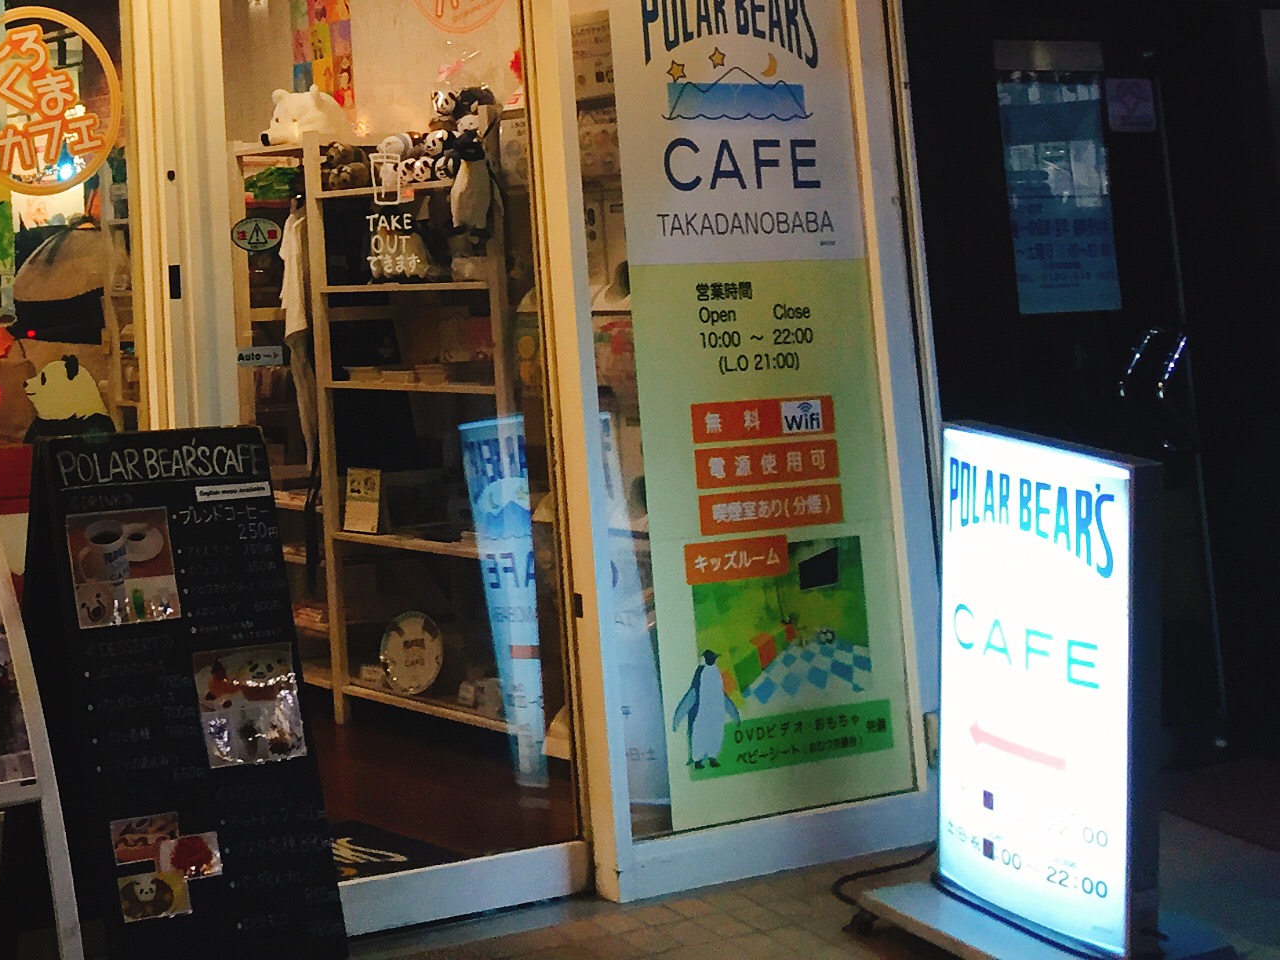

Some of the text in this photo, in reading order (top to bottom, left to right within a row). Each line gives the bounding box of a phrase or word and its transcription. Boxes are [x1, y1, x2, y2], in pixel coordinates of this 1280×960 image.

[663, 137, 821, 192] CAFE
[365, 213, 413, 232] TAKE
[656, 209, 835, 238] TAKADANOBABA
[371, 234, 412, 254] OUT
[366, 253, 421, 274] できます
[695, 280, 754, 302] 営業時間
[698, 303, 811, 326] Open Close
[699, 331, 742, 350] 10:00
[772, 327, 814, 347] 22:00
[237, 352, 262, 362] Auto
[753, 350, 801, 372] 21:00)
[783, 411, 820, 431] Wifi
[56, 437, 265, 486] POLAR BEAR'S CAFE
[949, 457, 1115, 579] POLAR BEAR'S
[237, 521, 279, 541] 250円
[693, 548, 781, 572] キッズルーム
[952, 603, 1100, 690] CAFE
[1046, 865, 1109, 899] 22:00
